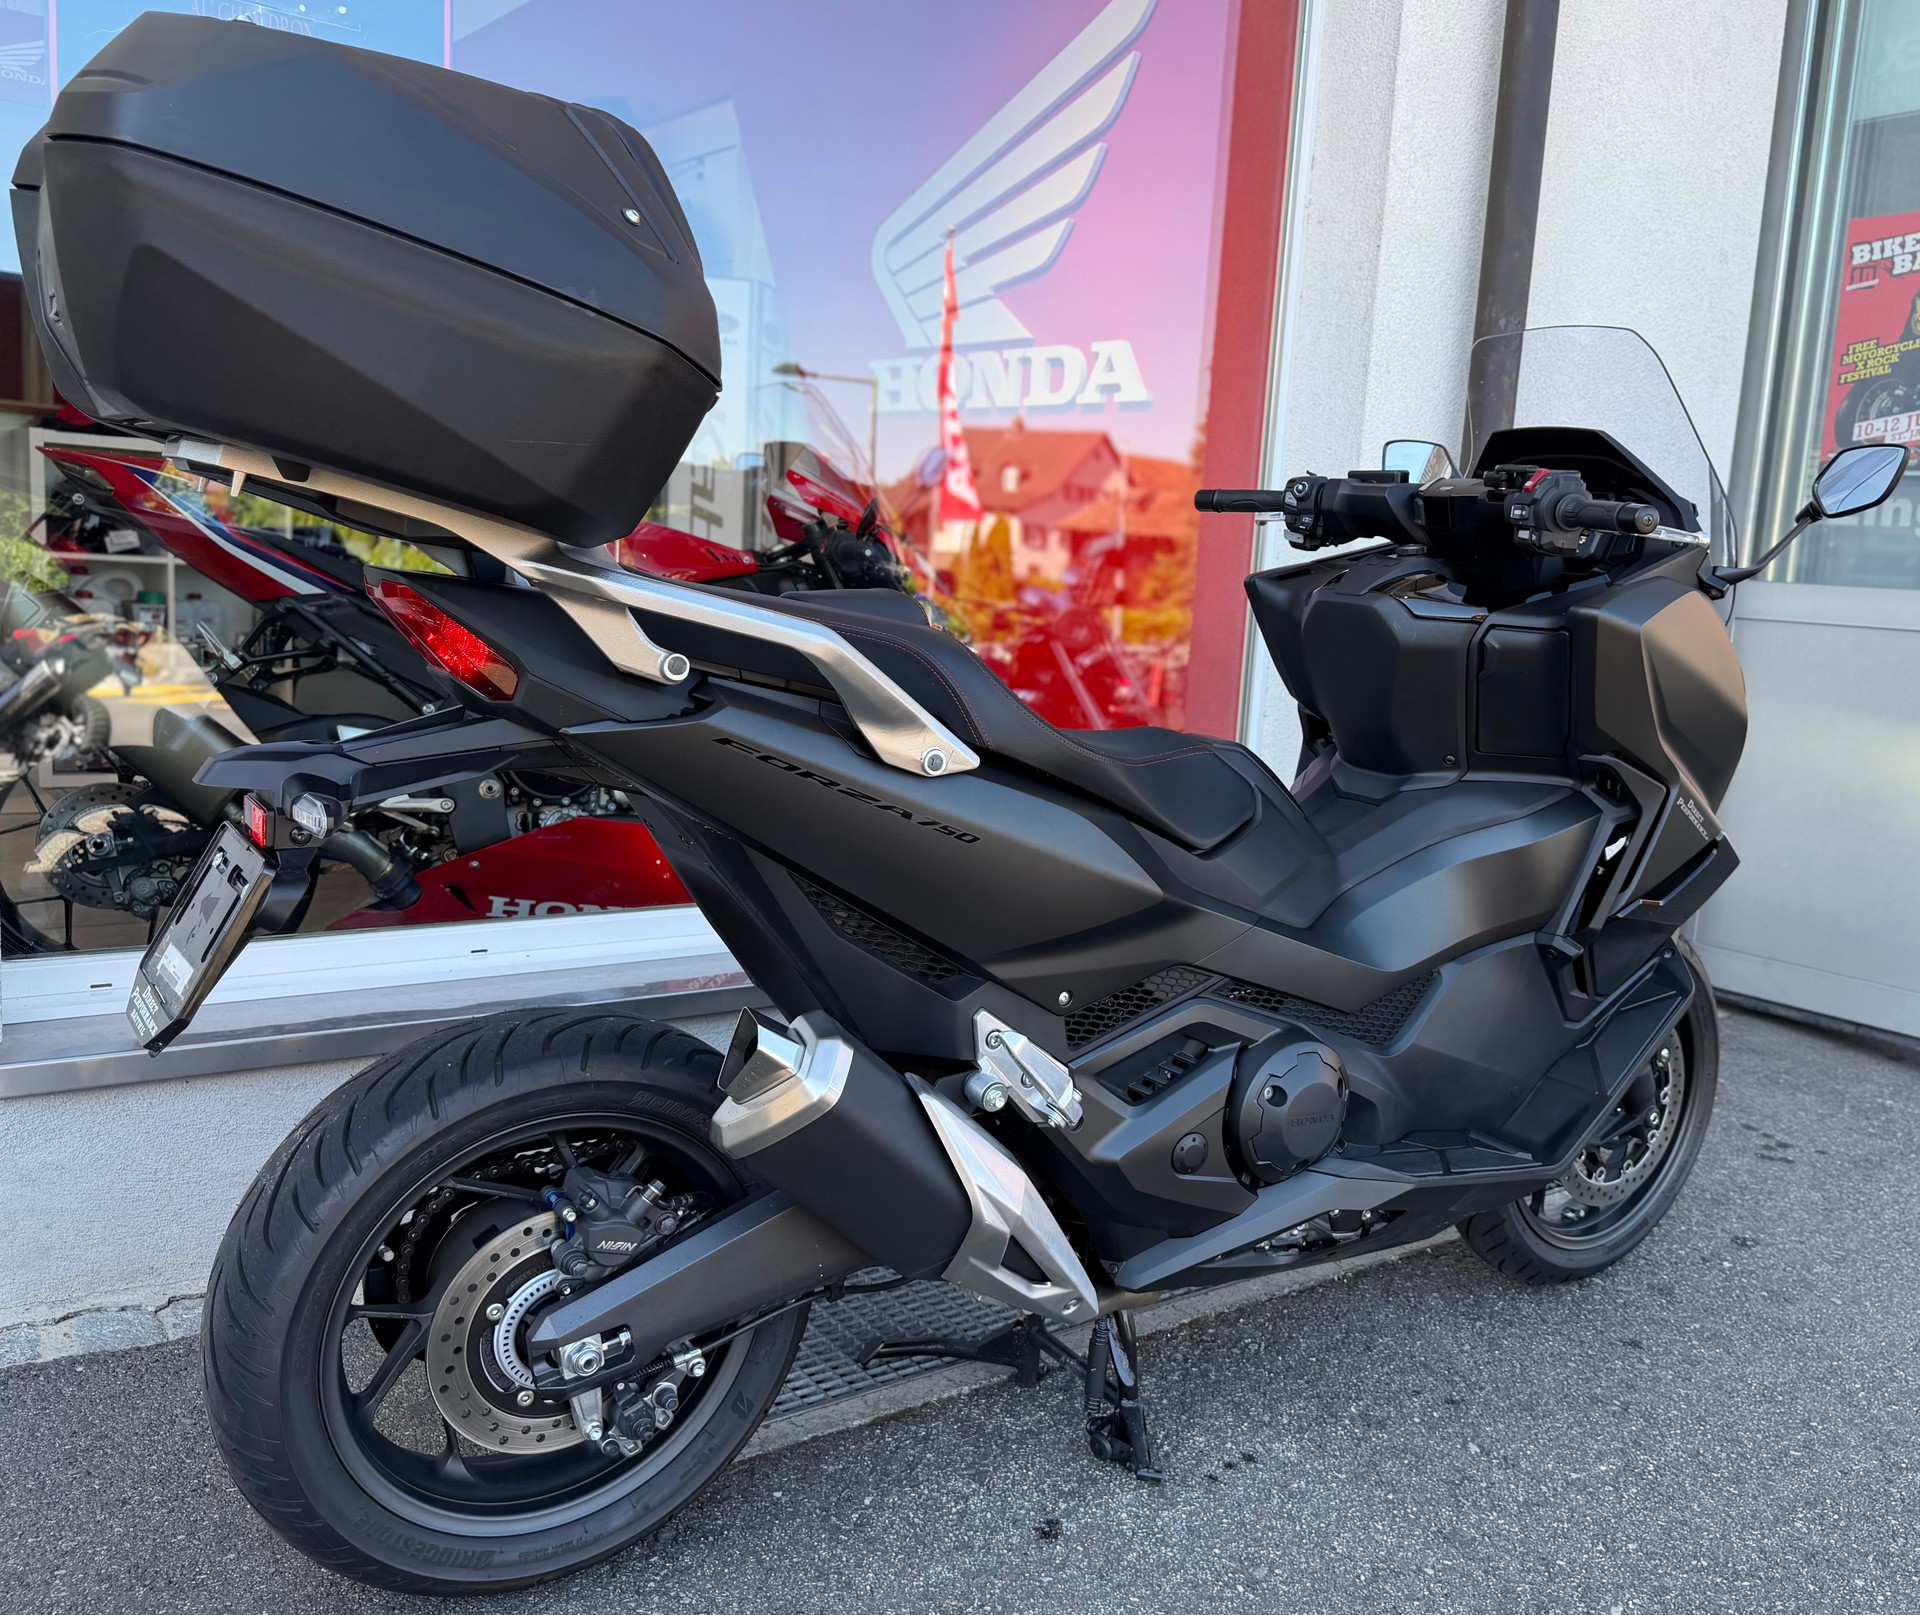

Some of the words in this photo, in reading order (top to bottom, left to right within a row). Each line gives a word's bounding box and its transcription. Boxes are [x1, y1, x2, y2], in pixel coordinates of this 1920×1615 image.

[1847, 339, 1878, 354] FREE
[1856, 360, 1866, 371] X
[1866, 353, 1900, 368] ROCK
[868, 339, 1153, 414] HONDA
[1839, 364, 1892, 384] FESTIVAL
[1856, 417, 1900, 438] 10-12
[712, 737, 913, 821] FORZA
[917, 815, 981, 844] 750
[141, 984, 159, 1015] DIRECT
[131, 986, 159, 1036] PERFORMANCE
[1290, 1113, 1335, 1127] HONDA
